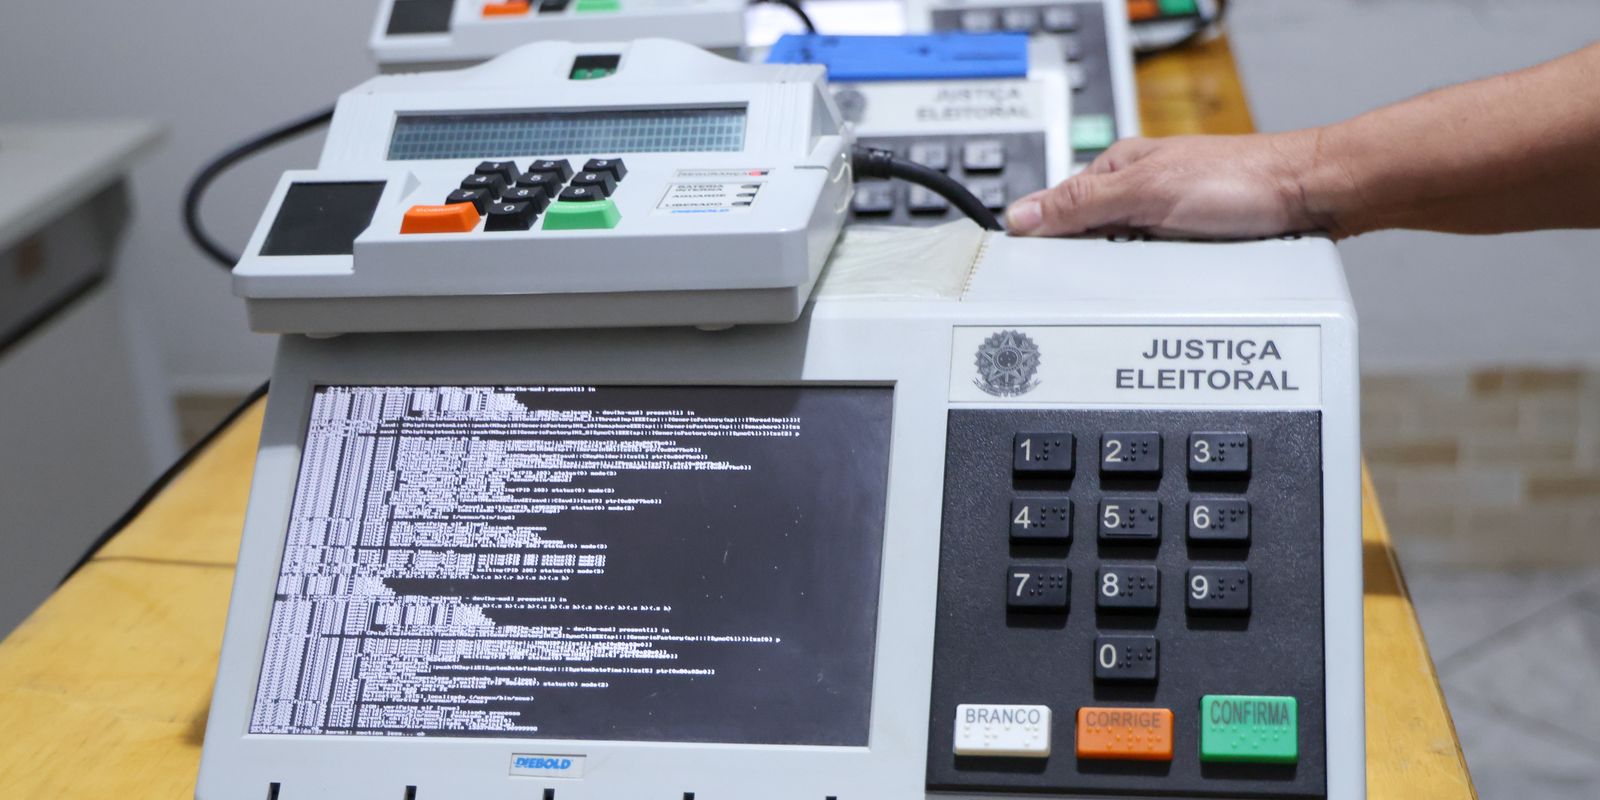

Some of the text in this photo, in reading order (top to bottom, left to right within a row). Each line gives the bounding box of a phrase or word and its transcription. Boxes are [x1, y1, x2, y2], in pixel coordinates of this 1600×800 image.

[916, 105, 1029, 121] ELEITORAL
[1142, 339, 1282, 366] JUSTIÇA
[1116, 369, 1300, 391] ELEITORAL
[1020, 439, 1031, 461] 1
[1104, 440, 1122, 463] 2
[1193, 440, 1210, 463] 3
[1014, 506, 1032, 528] 4
[1104, 505, 1121, 528] 5
[1193, 506, 1210, 529] 6
[1013, 573, 1030, 596] 7
[1102, 573, 1119, 597] 8
[1191, 575, 1209, 599] 9
[1099, 644, 1117, 668] 0
[965, 709, 1040, 725] BRANCO
[1086, 711, 1162, 727] CORRIGE
[1210, 700, 1290, 726] CONFIRMA
[514, 757, 571, 770] DIEBOLD
